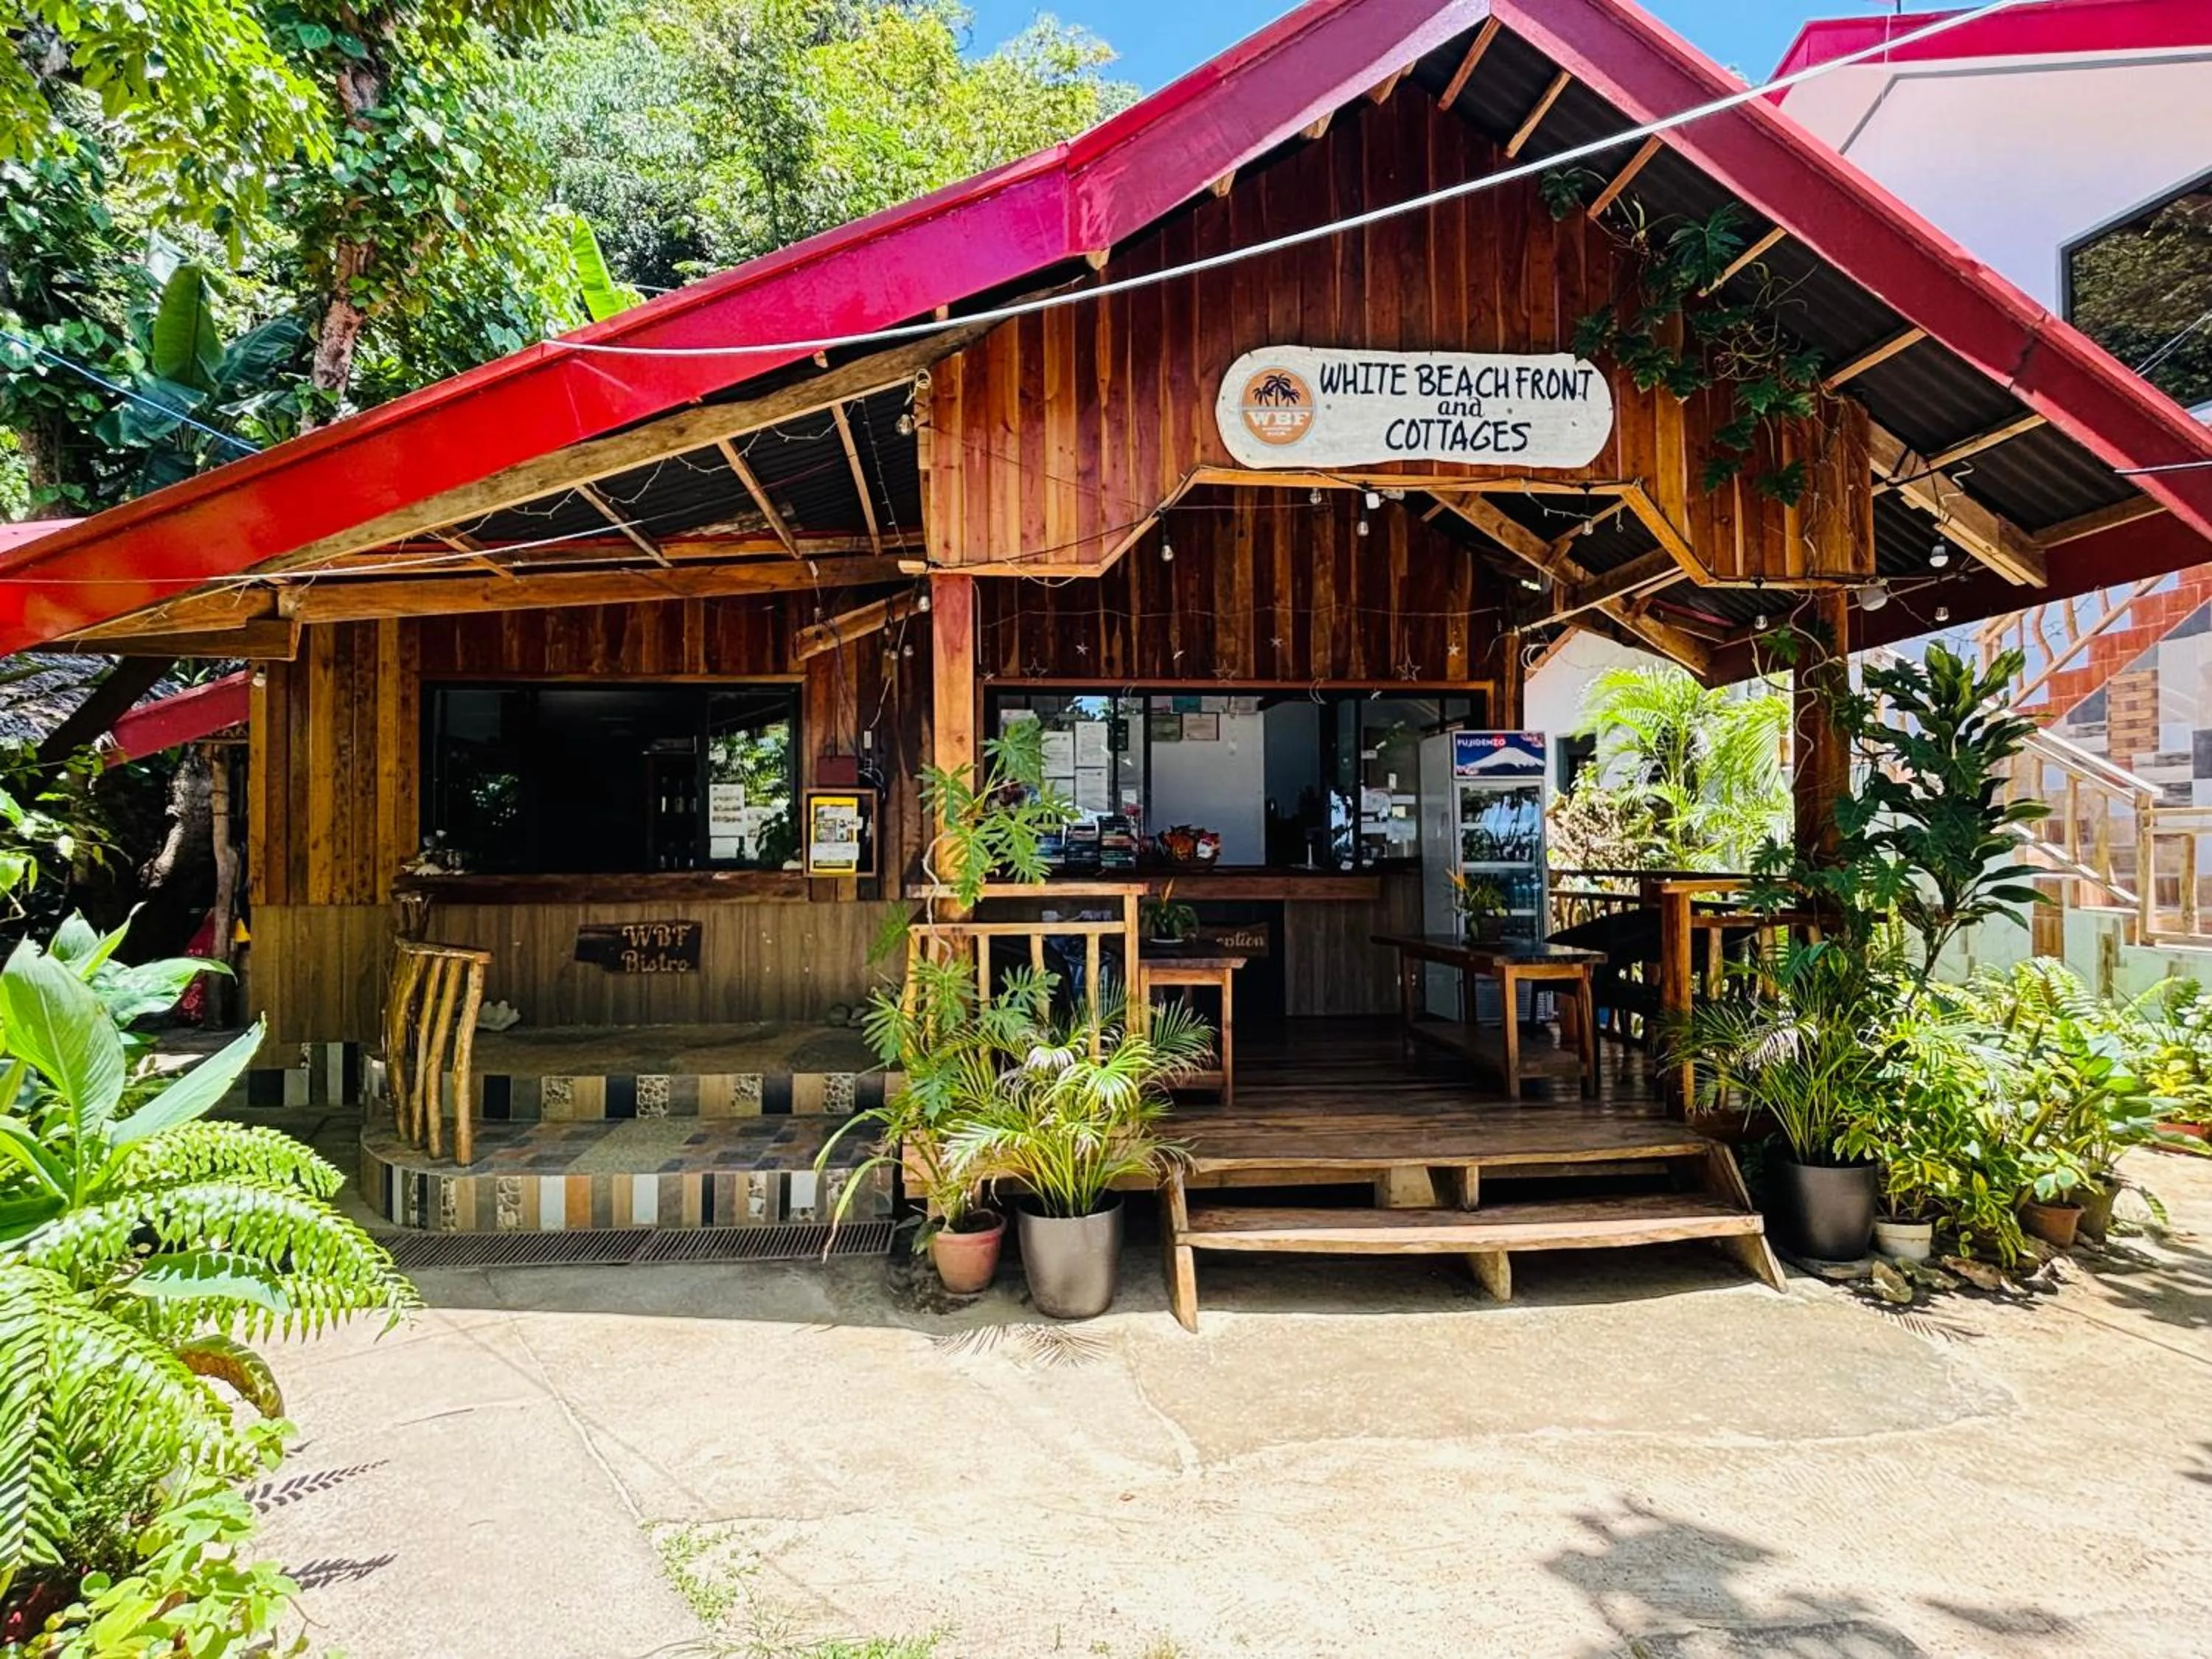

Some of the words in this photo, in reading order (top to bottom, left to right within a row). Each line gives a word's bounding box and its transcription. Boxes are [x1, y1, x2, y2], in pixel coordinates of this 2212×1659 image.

[1319, 362, 1407, 396] WHITE
[1247, 411, 1310, 426] WBF
[1437, 397, 1484, 418] and
[1385, 418, 1532, 452] COTTAGES
[1456, 737, 1506, 748] FUJIDENZO
[622, 923, 692, 947] WBF
[620, 949, 690, 973] Bistro
